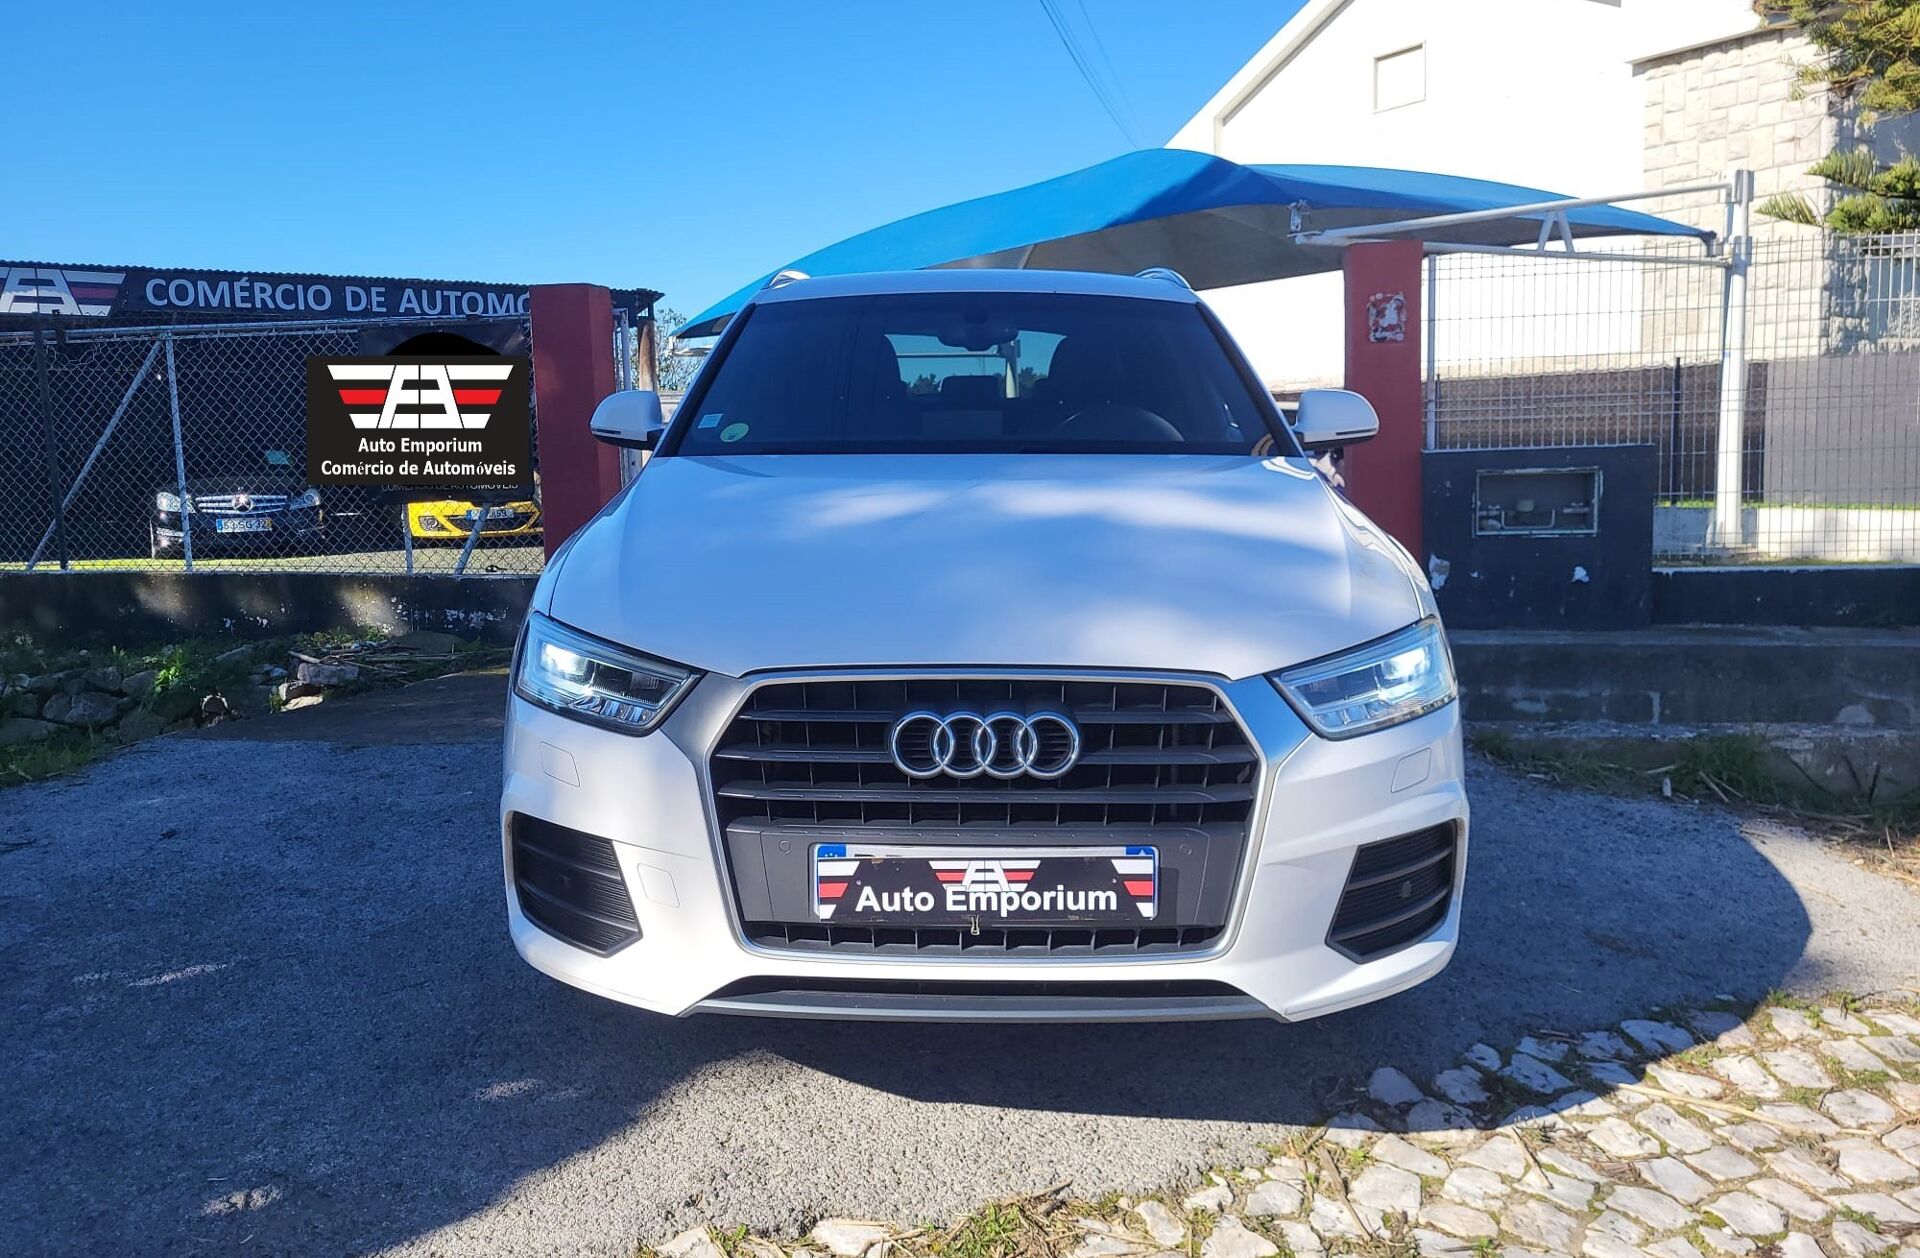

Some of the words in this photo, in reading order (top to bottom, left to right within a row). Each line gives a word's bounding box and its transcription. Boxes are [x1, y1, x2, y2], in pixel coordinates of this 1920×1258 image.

[146, 277, 332, 312] COMÉRCIO
[344, 286, 387, 313] DE
[855, 885, 935, 912] Auto
[946, 884, 1117, 917] Emporium
